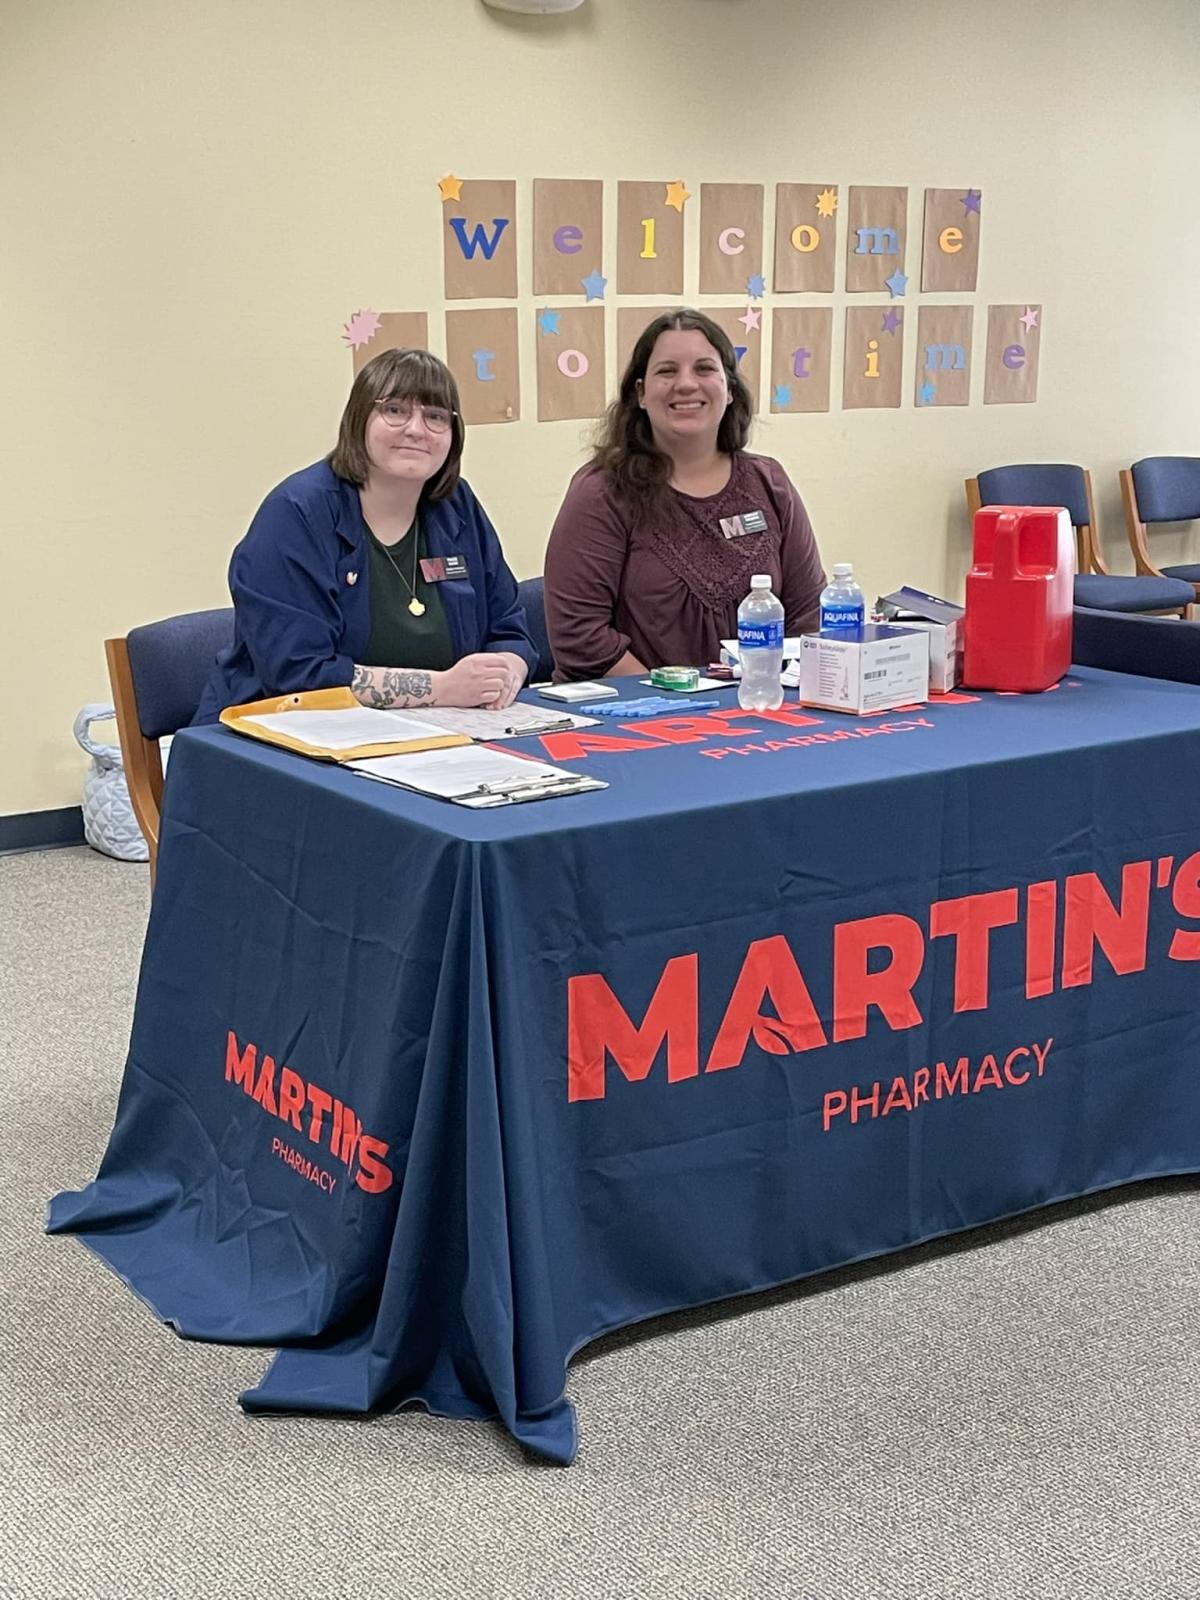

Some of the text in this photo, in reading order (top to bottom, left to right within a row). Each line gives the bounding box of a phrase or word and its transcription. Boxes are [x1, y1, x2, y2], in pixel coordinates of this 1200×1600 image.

[449, 215, 964, 261] Welcome
[823, 612, 860, 622] AQUAFINA
[699, 717, 936, 760] PHARMACY
[822, 1037, 1054, 1132] PHARMACY
[225, 1031, 393, 1194] MARTINS
[271, 1137, 337, 1195] PHARMACY
